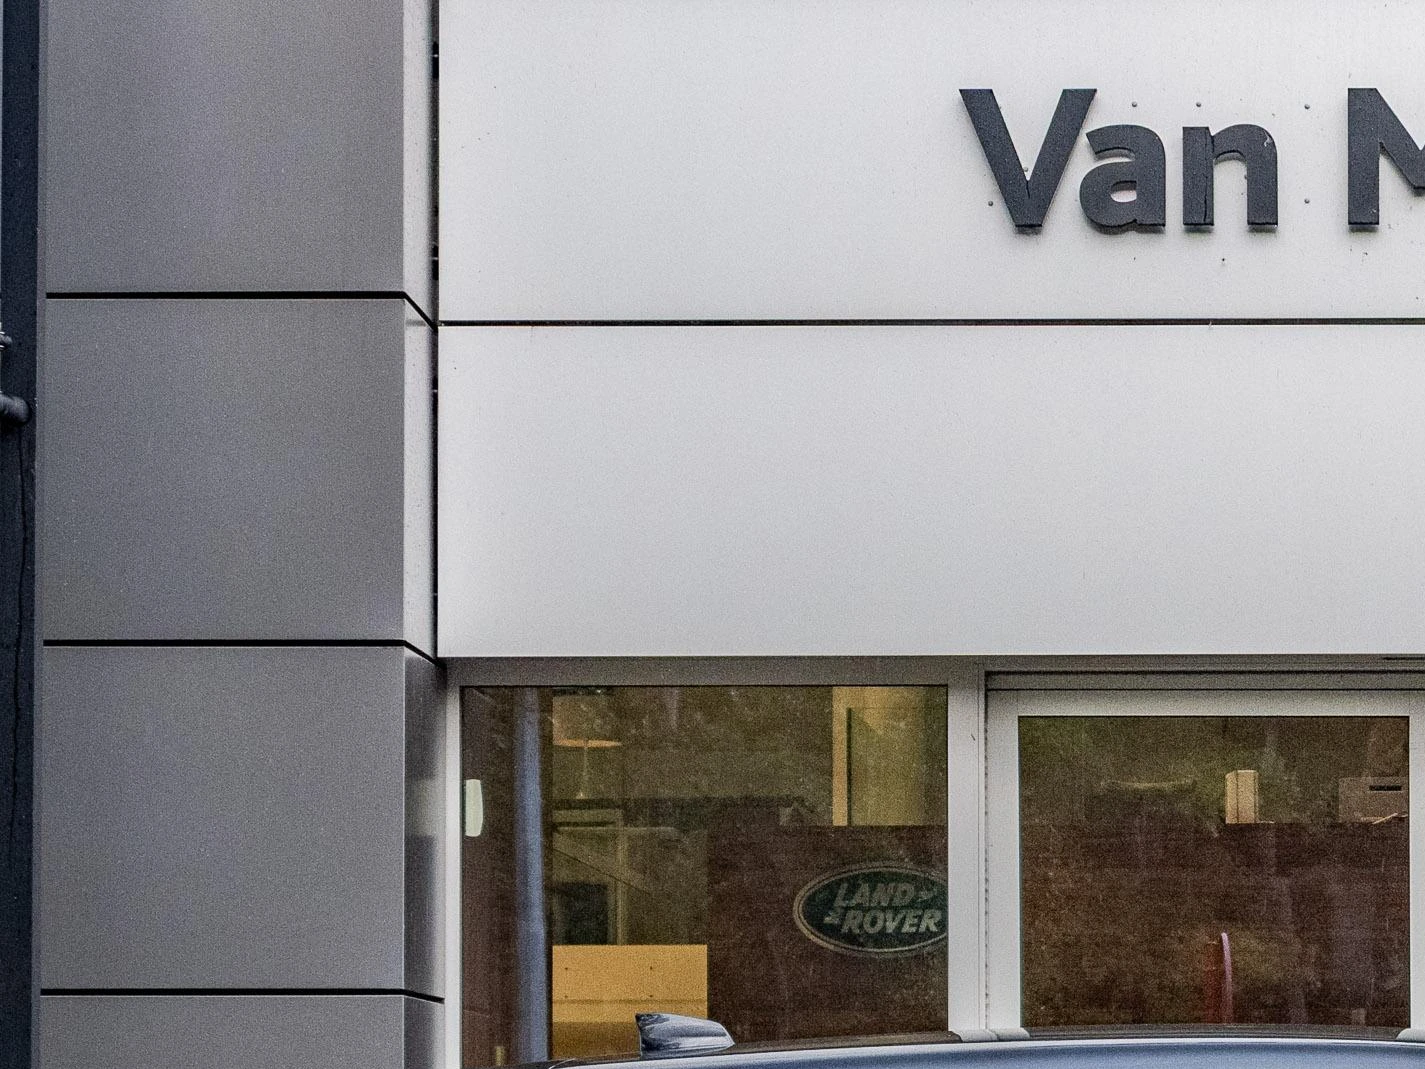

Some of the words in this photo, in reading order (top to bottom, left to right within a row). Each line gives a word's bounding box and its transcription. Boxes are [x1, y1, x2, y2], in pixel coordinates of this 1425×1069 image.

[958, 87, 1279, 233] Van
[833, 882, 916, 908] LAND
[841, 908, 942, 934] ROVER
